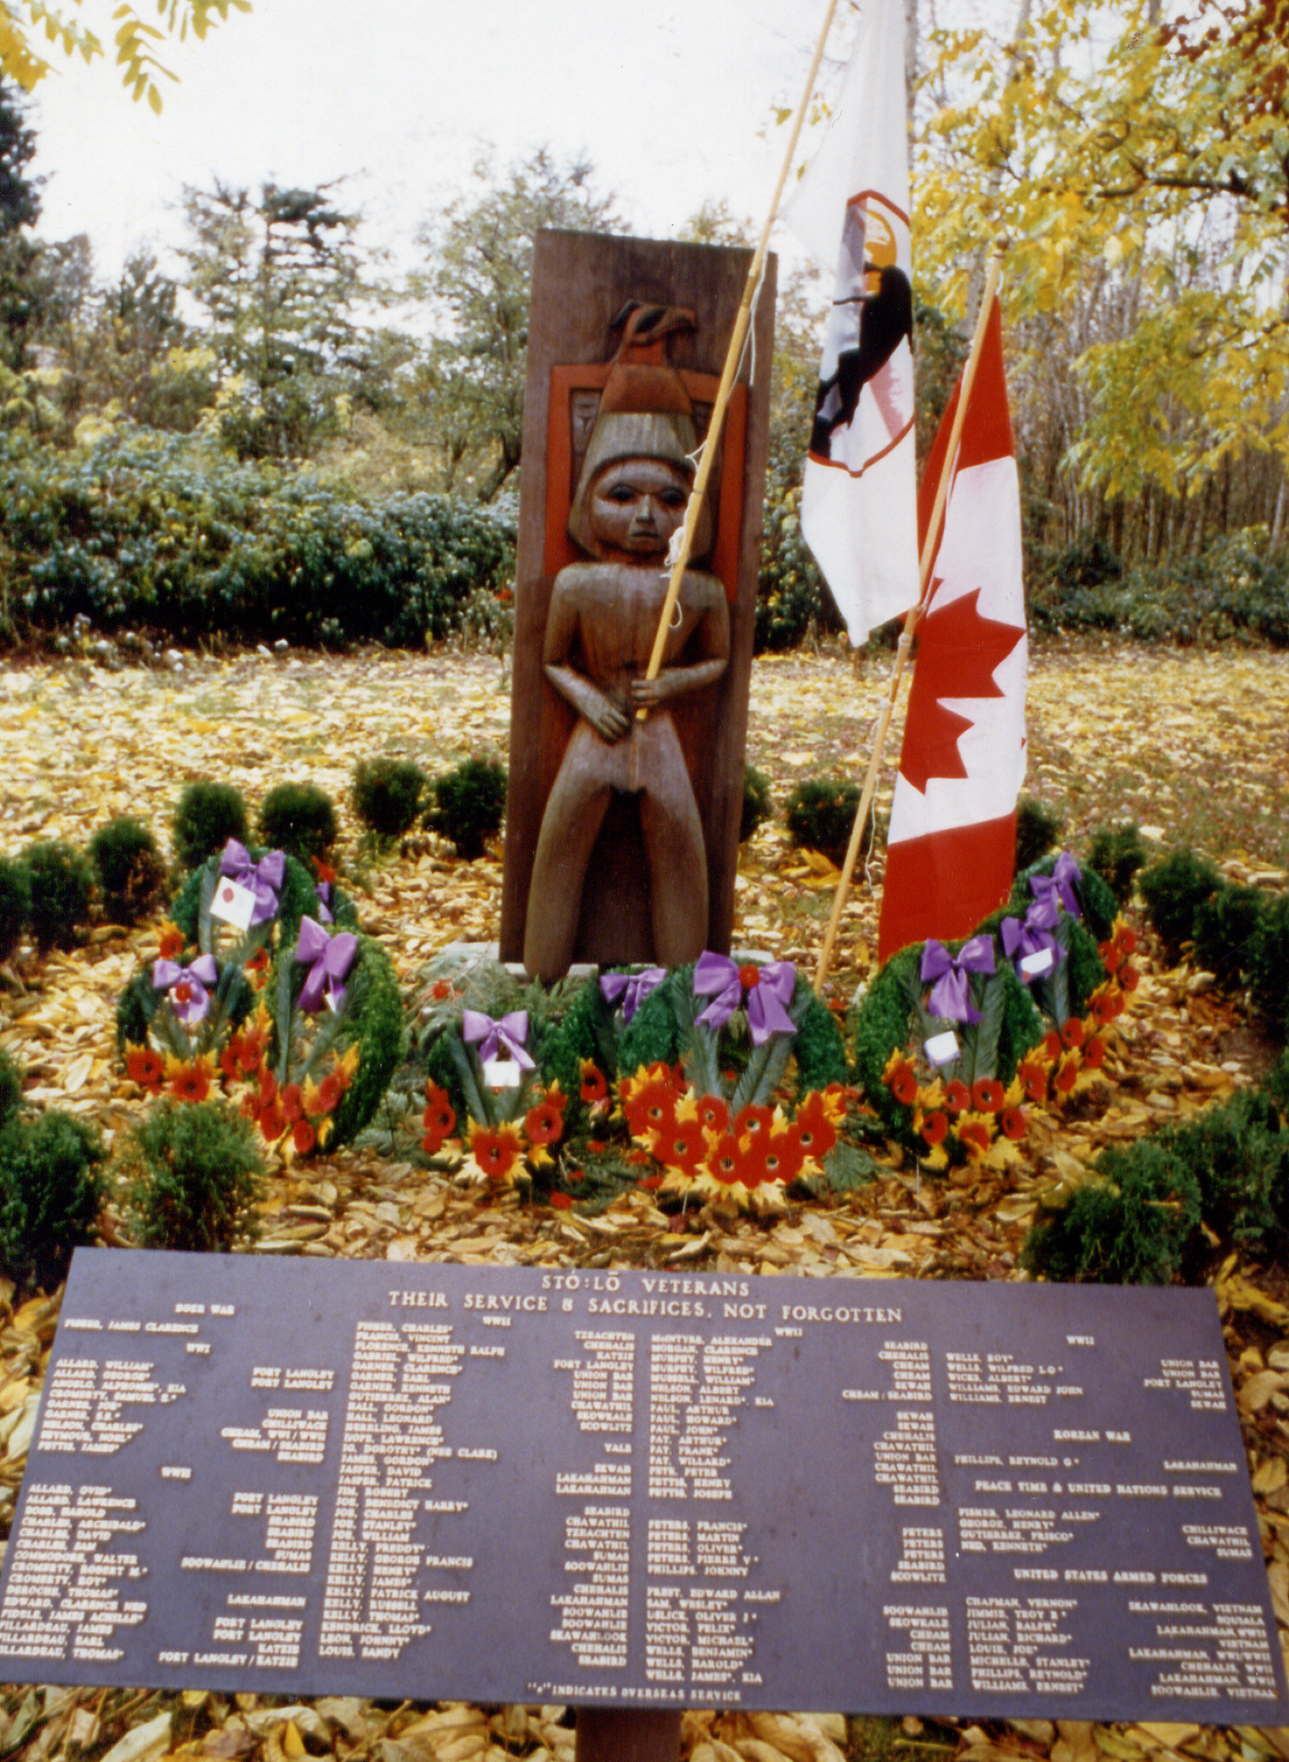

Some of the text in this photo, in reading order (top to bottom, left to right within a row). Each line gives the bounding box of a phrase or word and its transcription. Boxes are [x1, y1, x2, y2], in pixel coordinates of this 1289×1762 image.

[642, 1278, 749, 1296] VETERANS
[210, 1304, 234, 1315] WAR
[389, 1291, 448, 1307] THEIR
[464, 1293, 547, 1311] SERVICE
[724, 1303, 766, 1319] NOT
[782, 1305, 901, 1322] FORGOTTEN
[470, 1346, 505, 1356] RALPH
[884, 1341, 928, 1351] SEABIRD
[554, 1359, 634, 1371] FORT LANGLEY
[893, 1361, 930, 1370] CHEAM
[253, 1367, 334, 1379] FORT LANGLEY
[574, 1370, 633, 1381] UNION BAR
[251, 1377, 333, 1390] FORT LANGLEY
[573, 1380, 633, 1391] UNION BAR
[1144, 1379, 1170, 1387] FORT
[268, 1409, 328, 1420] UNION BAR
[383, 1413, 433, 1424] LEONARD
[1053, 1429, 1131, 1442] KOREAN WAR
[277, 1451, 324, 1462] SEABIRD
[387, 1466, 422, 1477] DAVID
[386, 1477, 432, 1488] PATRICK
[694, 1478, 730, 1488] HENRY
[975, 1480, 1012, 1491] PEACE
[1018, 1482, 1047, 1492] TIME
[1068, 1483, 1111, 1493] UNITED
[1116, 1484, 1168, 1495] NATIONS
[1173, 1486, 1222, 1497] SERVICE
[234, 1492, 318, 1505] FORT LANGLEY
[232, 1503, 317, 1516] FORT LANGLEY
[584, 1506, 630, 1517] SEABIRD
[1005, 1509, 1055, 1519] LEONARD
[268, 1515, 315, 1527] SEABIRD
[267, 1527, 314, 1539] SEABIRD
[362, 1531, 410, 1542] WILLIAM
[697, 1533, 739, 1542] MARTIN
[266, 1538, 313, 1550] SEABIRD
[331, 1541, 368, 1552] KELLY,
[330, 1552, 367, 1563] KELLY,
[426, 1556, 473, 1568] FRANCIS
[898, 1561, 945, 1571] SEABIRD
[1014, 1568, 1208, 1584] UNITED STATES ARMED FORCES
[326, 1586, 363, 1597] KELLY,
[371, 1588, 418, 1600] PATRICK
[324, 1598, 362, 1609] KELLY,
[215, 1617, 303, 1631] FORT LANGLEY
[910, 1629, 950, 1640] CHEAM
[579, 1654, 627, 1666] SEABIRD
[886, 1653, 950, 1664] UNION BAR
[552, 1684, 741, 1702] INDICATES OVERSEAS SERVICE
